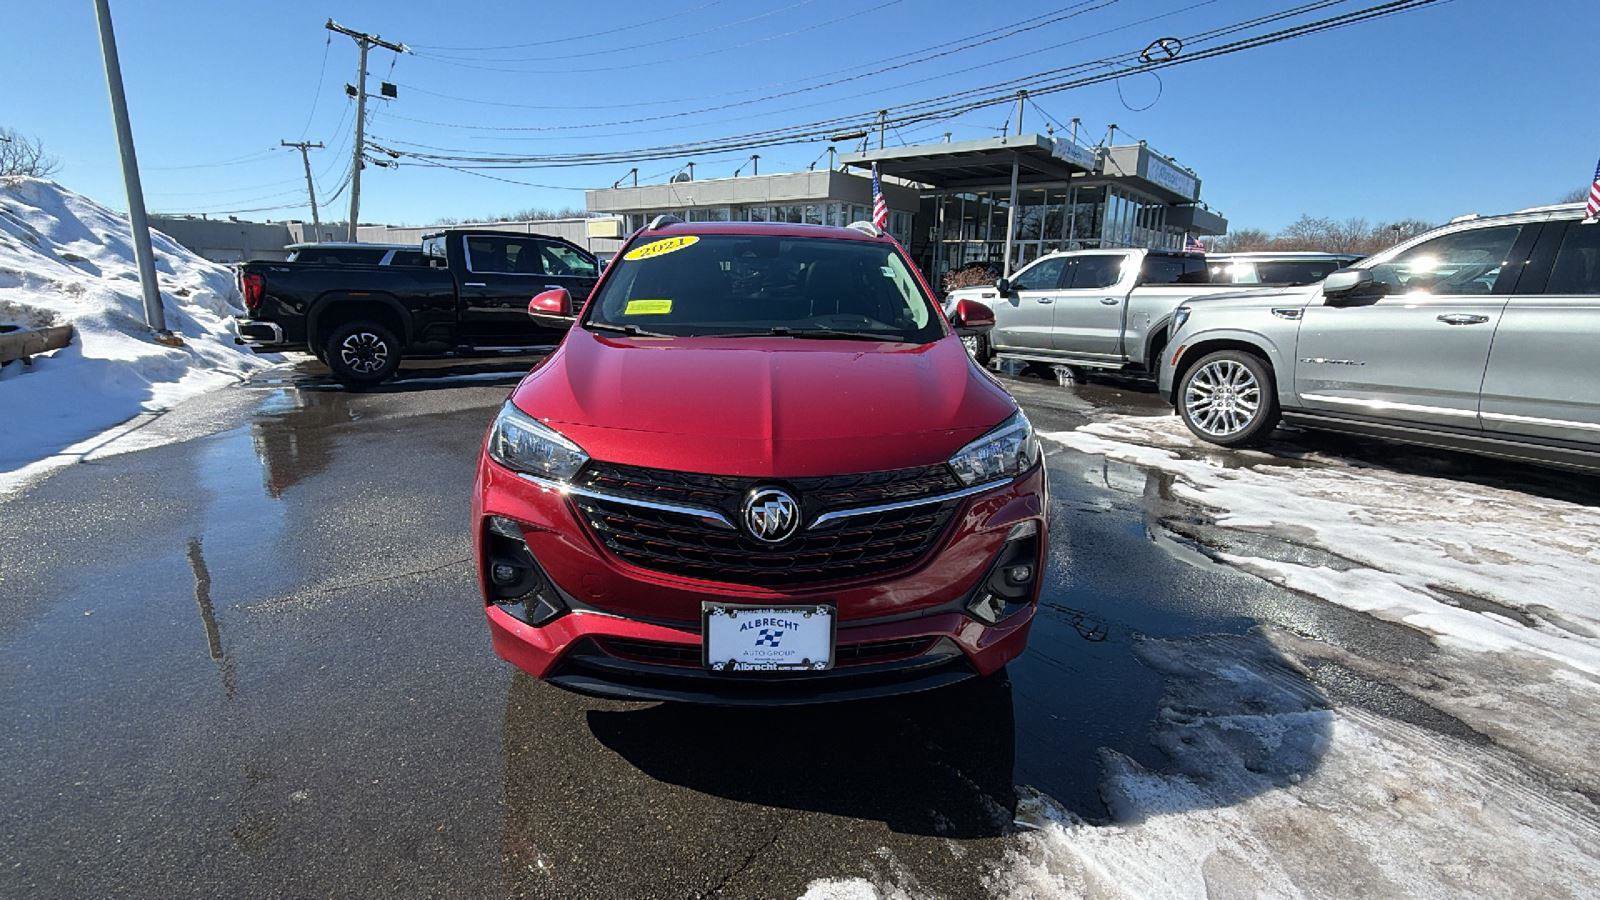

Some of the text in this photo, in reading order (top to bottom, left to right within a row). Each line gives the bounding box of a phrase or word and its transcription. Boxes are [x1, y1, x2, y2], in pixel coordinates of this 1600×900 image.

[640, 238, 685, 257] 2021
[740, 618, 800, 632] ALBRECHT
[733, 662, 777, 671] Albrecht
